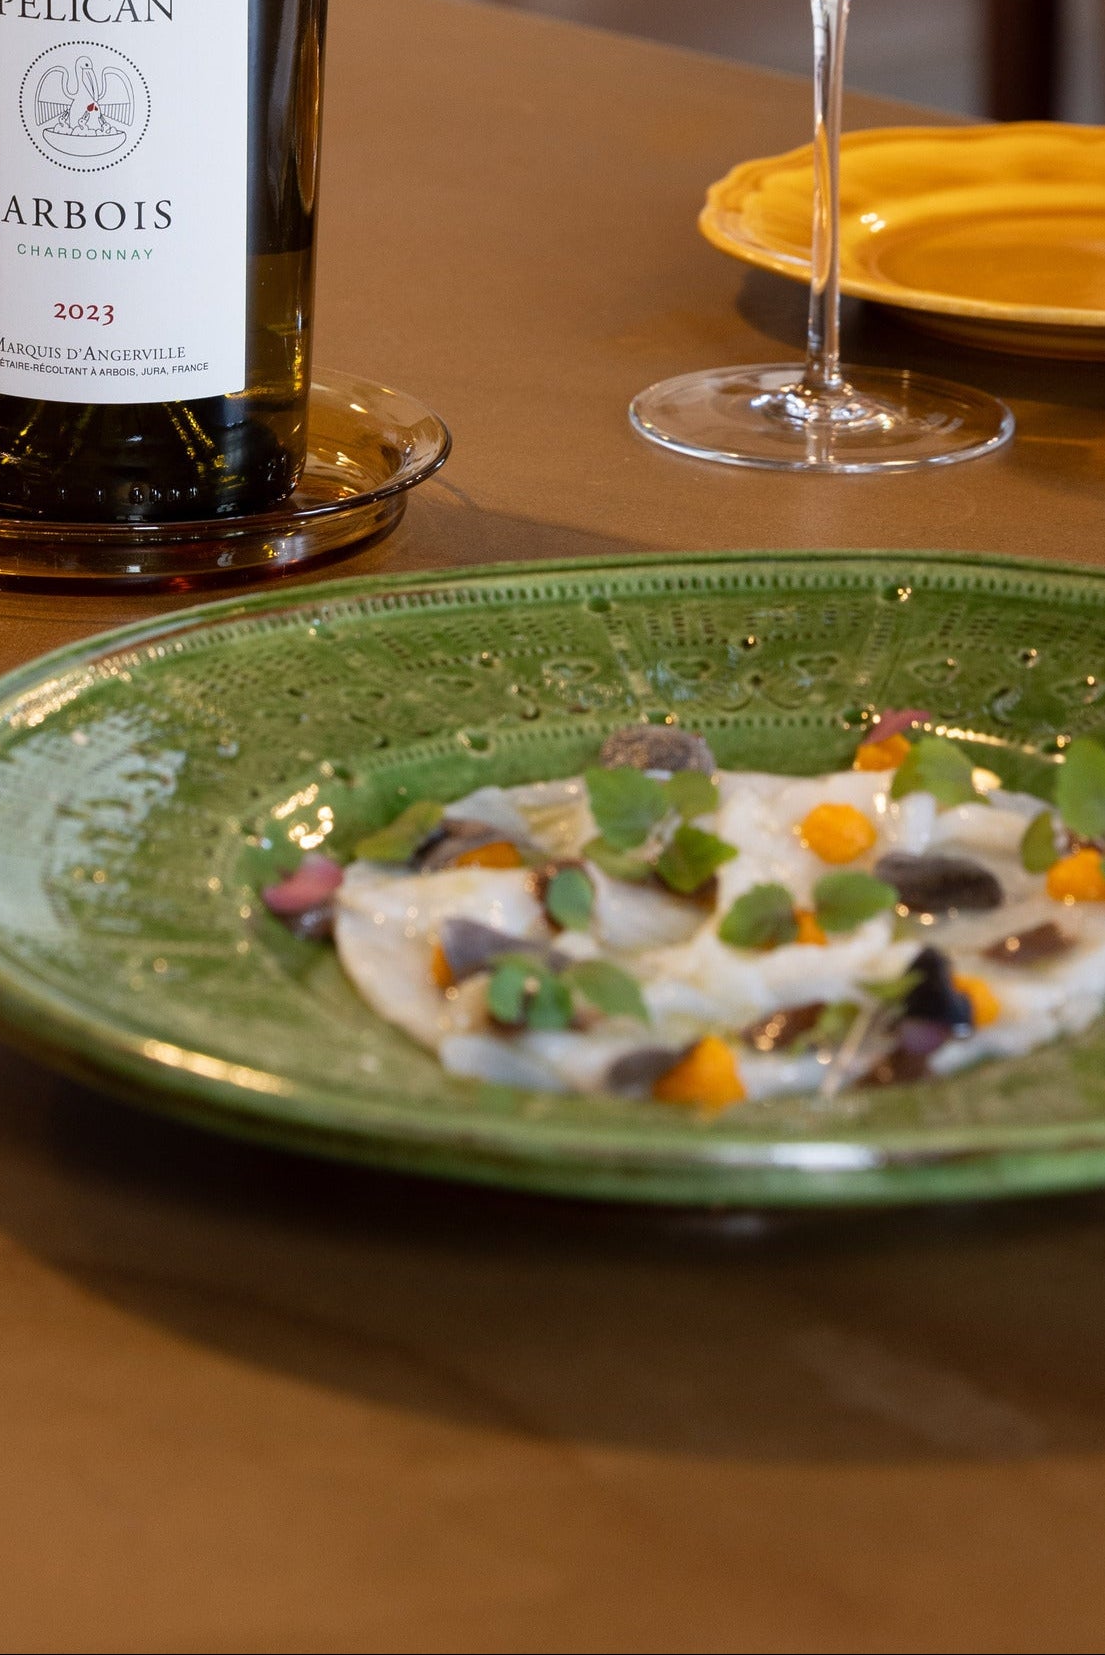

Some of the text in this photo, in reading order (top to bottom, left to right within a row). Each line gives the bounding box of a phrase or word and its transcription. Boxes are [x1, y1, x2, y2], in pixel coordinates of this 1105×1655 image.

[1, 194, 172, 231] ARBOIS
[17, 243, 153, 261] CHARDONNAY
[53, 302, 115, 326] 2023
[90, 364, 97, 376] À
[99, 367, 139, 377] ARBOIS,
[141, 366, 169, 376] JURA,
[172, 361, 209, 374] FRANCE
